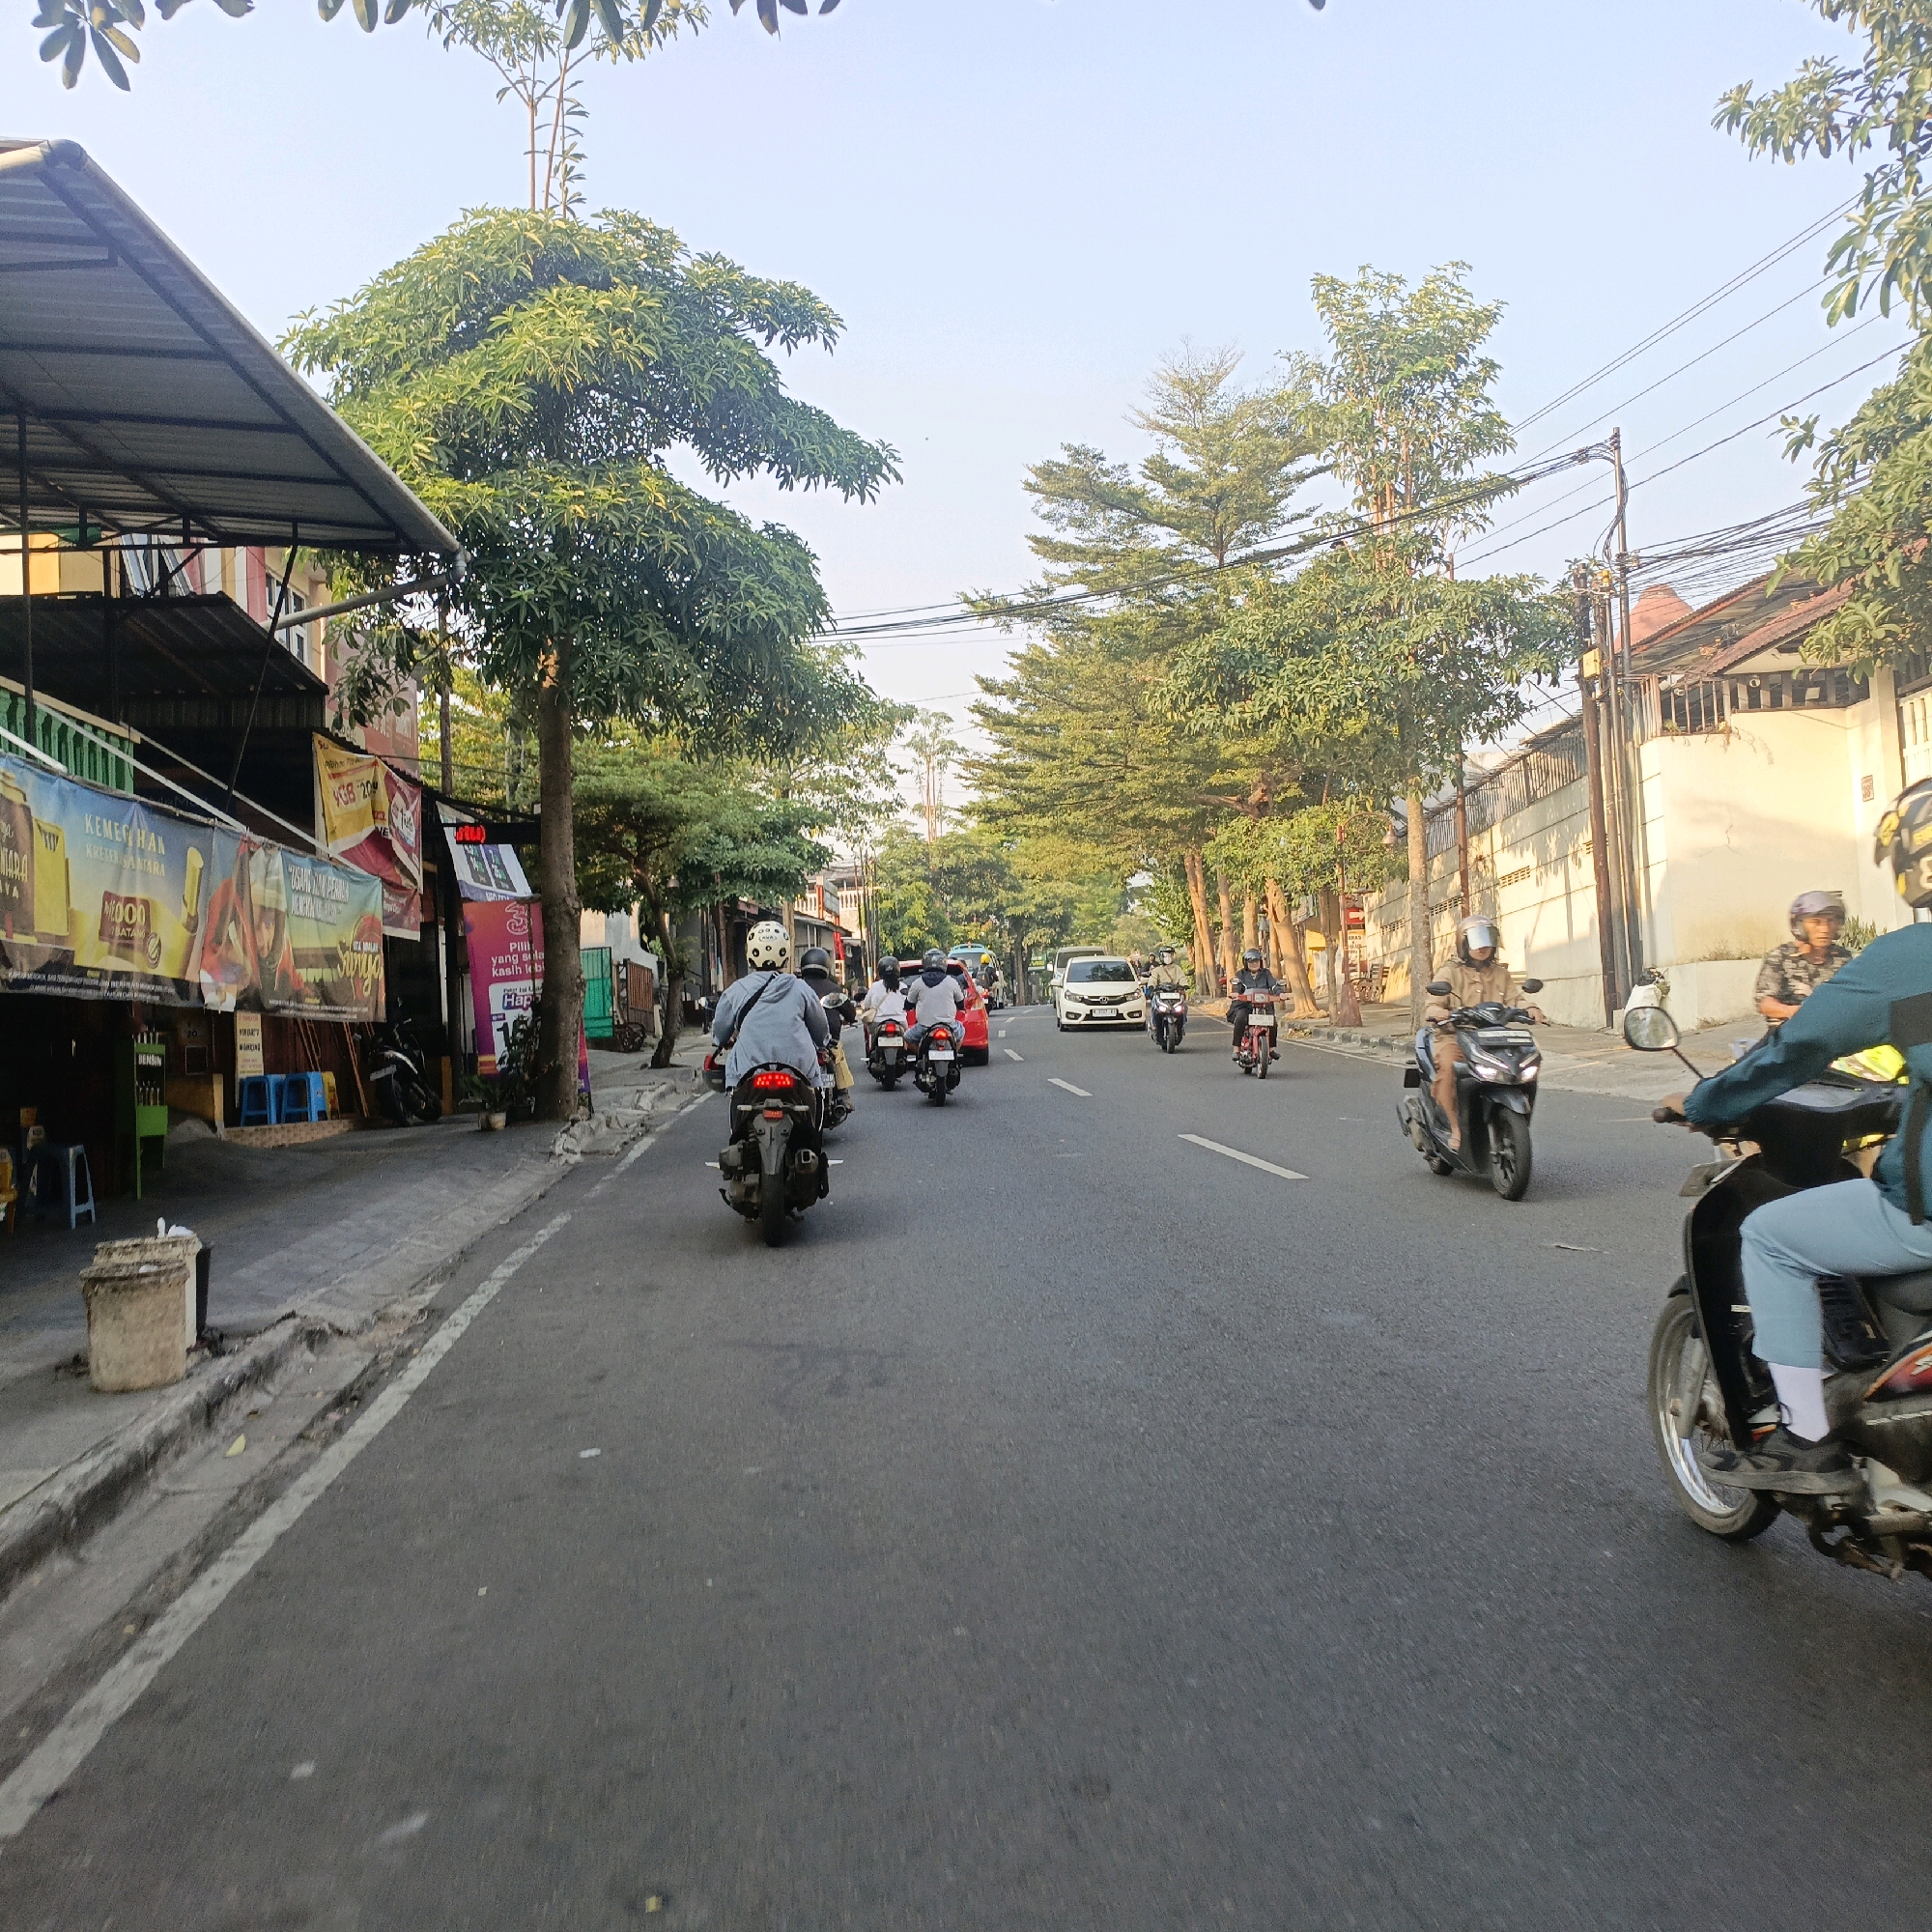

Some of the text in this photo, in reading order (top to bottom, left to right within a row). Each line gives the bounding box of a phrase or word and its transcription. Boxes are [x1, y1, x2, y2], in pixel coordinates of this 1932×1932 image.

[0, 819, 14, 843] ya
[491, 950, 545, 967] yang sela
[492, 964, 522, 978] kasih
[504, 994, 541, 1008] Hap
